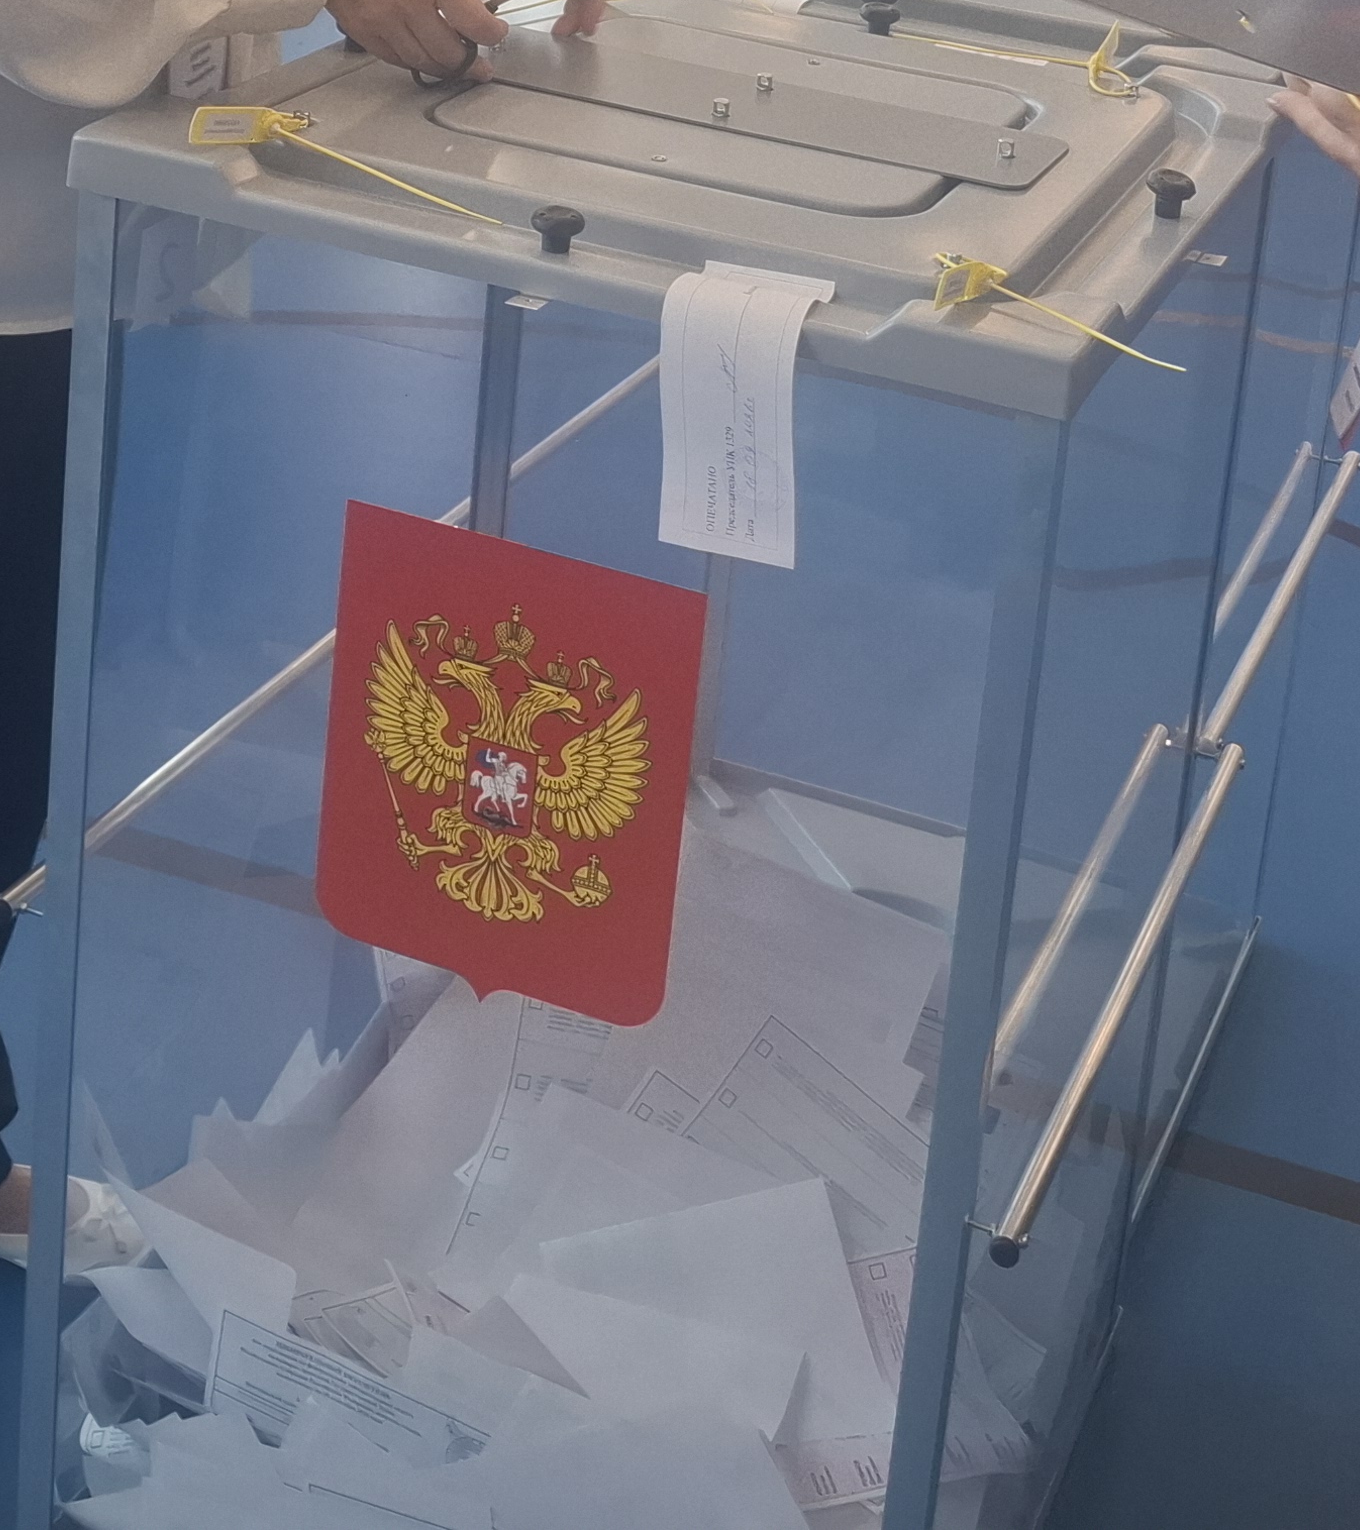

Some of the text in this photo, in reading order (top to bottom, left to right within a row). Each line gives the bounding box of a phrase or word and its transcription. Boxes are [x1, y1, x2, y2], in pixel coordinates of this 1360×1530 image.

[705, 465, 717, 532] ОПЕЧАТАНО
[724, 426, 737, 536] Председатель УИК 1329
[745, 519, 756, 543] Дата
